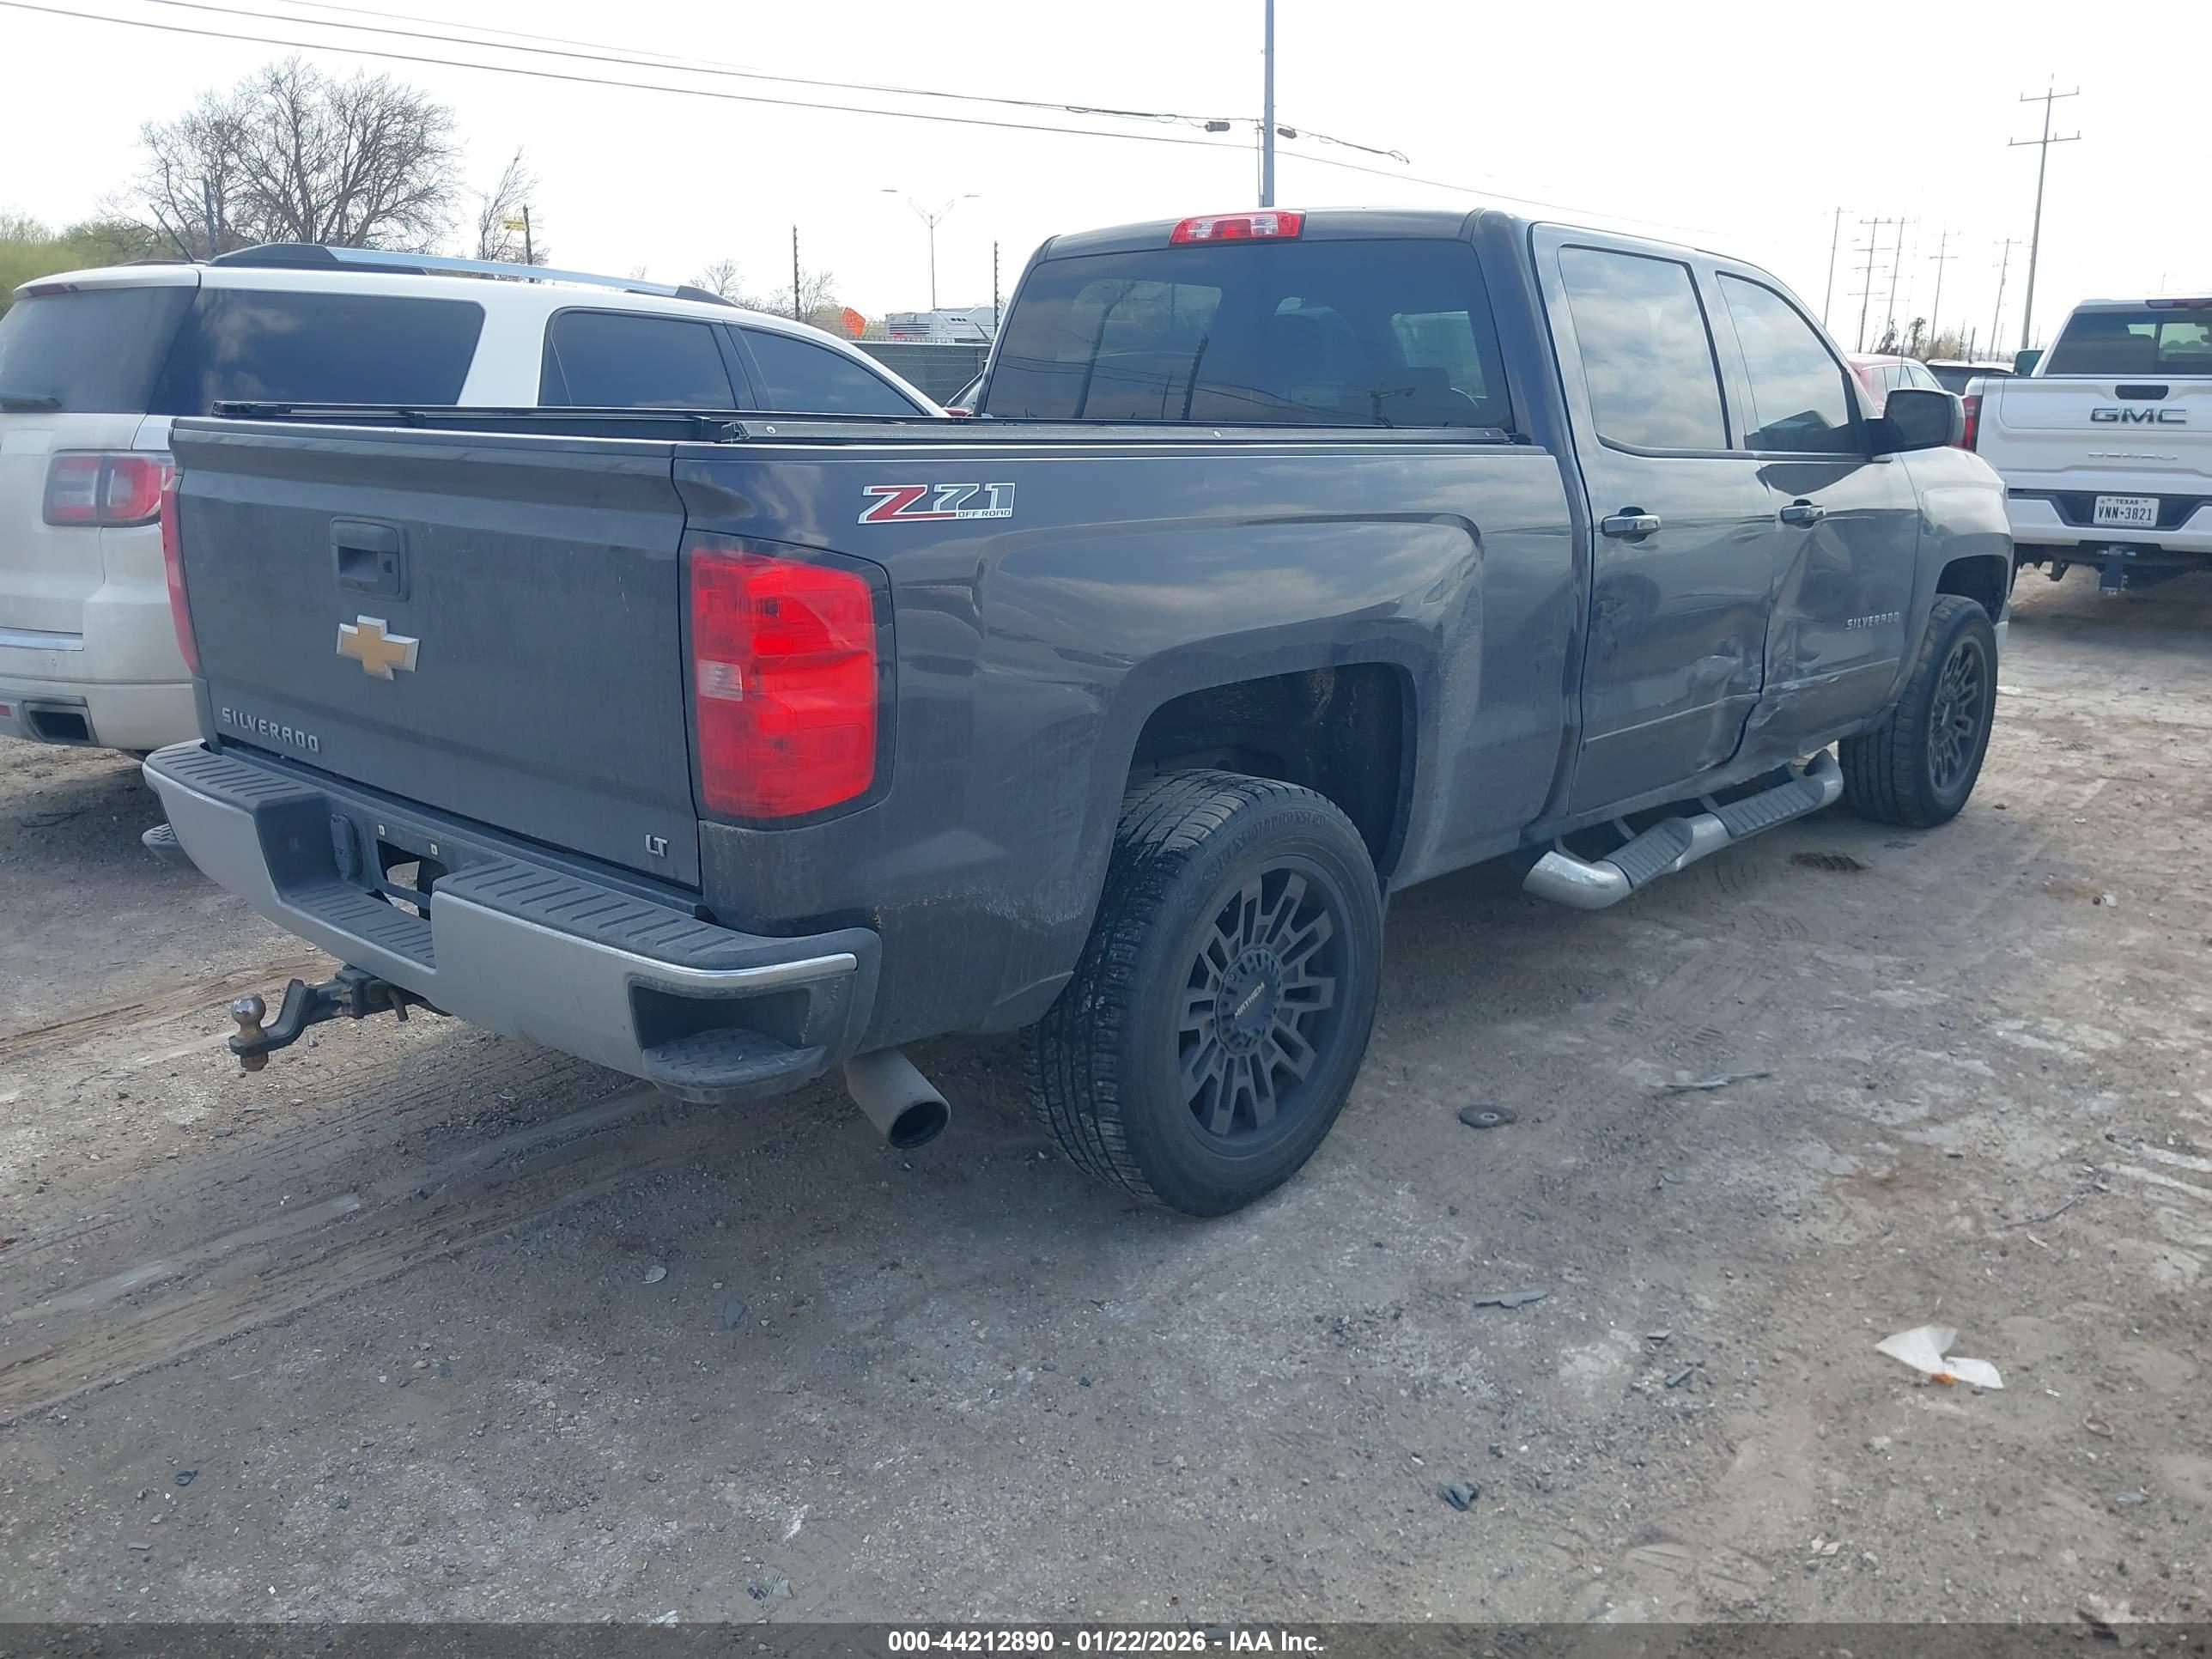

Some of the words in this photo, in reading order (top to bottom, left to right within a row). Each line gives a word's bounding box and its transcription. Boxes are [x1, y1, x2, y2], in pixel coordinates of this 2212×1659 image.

[2090, 408, 2187, 424] GMC
[858, 483, 1015, 525] Z71
[957, 510, 981, 519] OFF
[981, 509, 1011, 518] ROAD
[1845, 611, 1899, 630] SILVERADO
[222, 707, 319, 754] SILVERADO
[645, 834, 668, 858] LT
